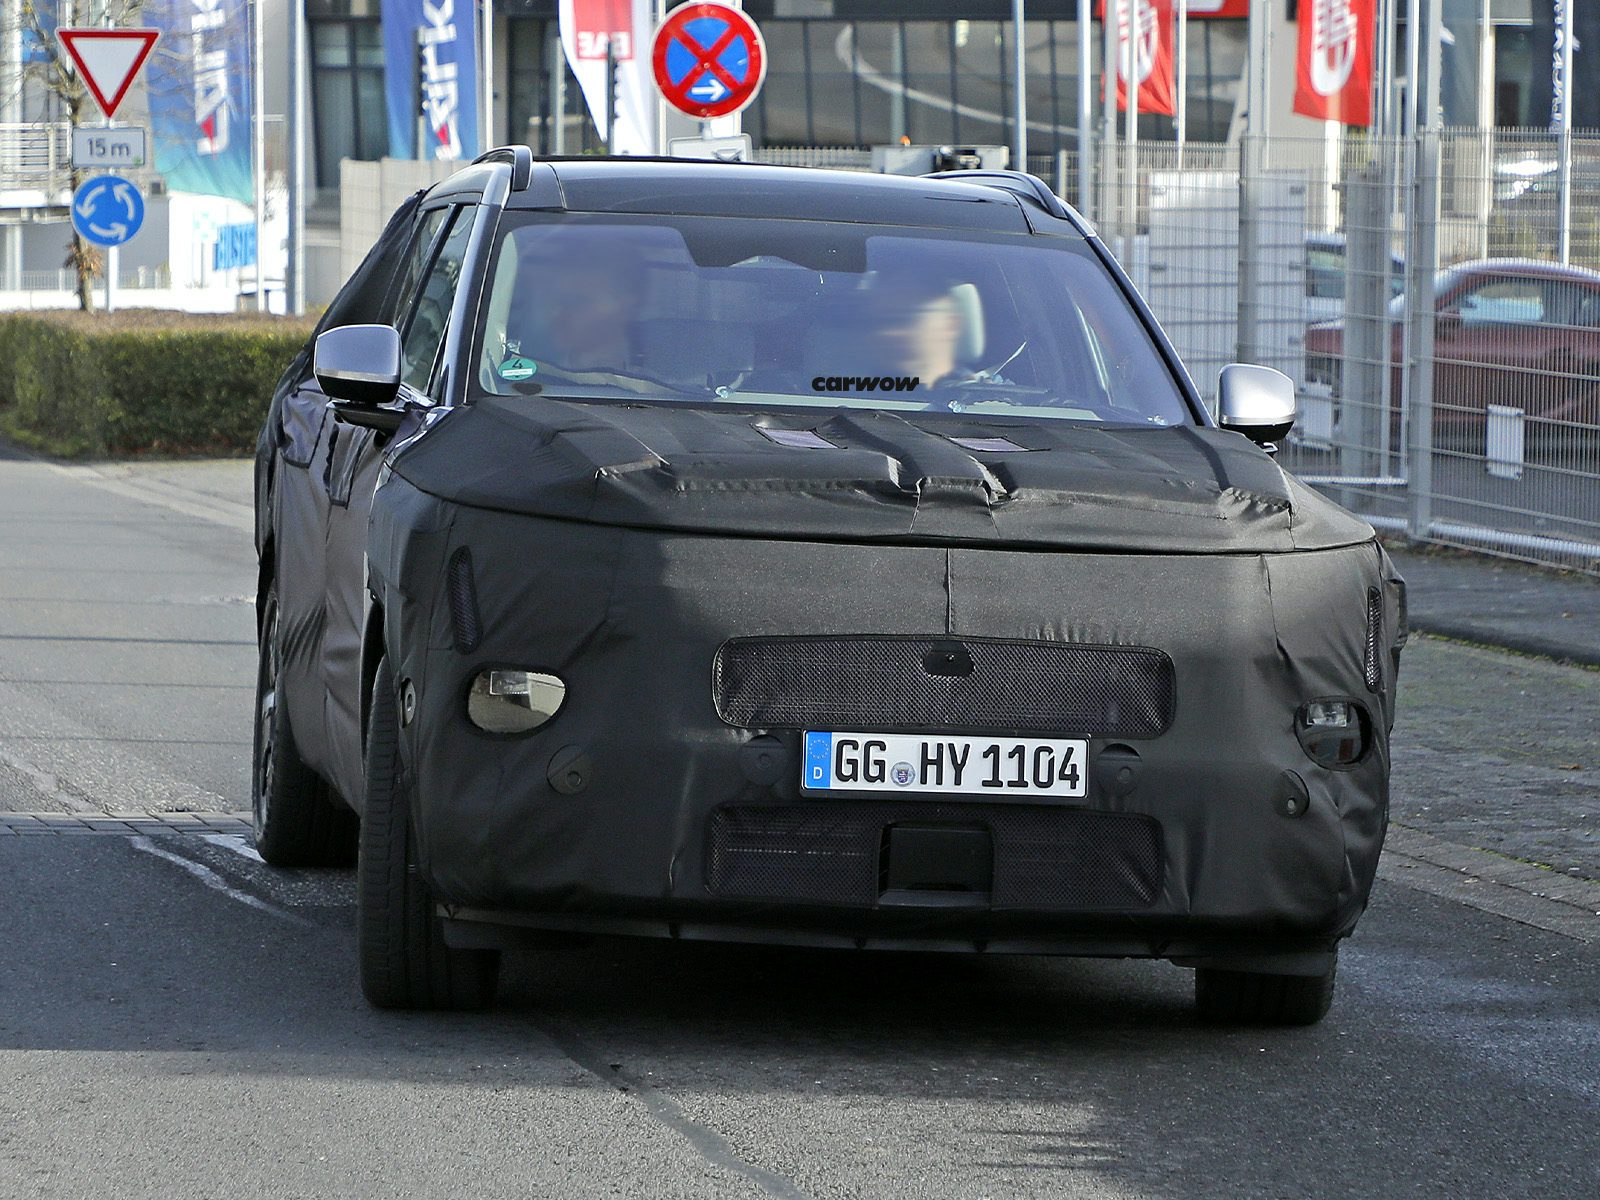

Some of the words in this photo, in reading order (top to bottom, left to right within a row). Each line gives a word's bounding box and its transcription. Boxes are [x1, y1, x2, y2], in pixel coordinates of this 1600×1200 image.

[87, 137, 106, 158] 15
[111, 143, 130, 157] m
[511, 358, 524, 369] 4
[813, 766, 823, 780] D
[834, 740, 887, 783] GG
[920, 742, 971, 786] HY
[981, 744, 1080, 790] 1104
